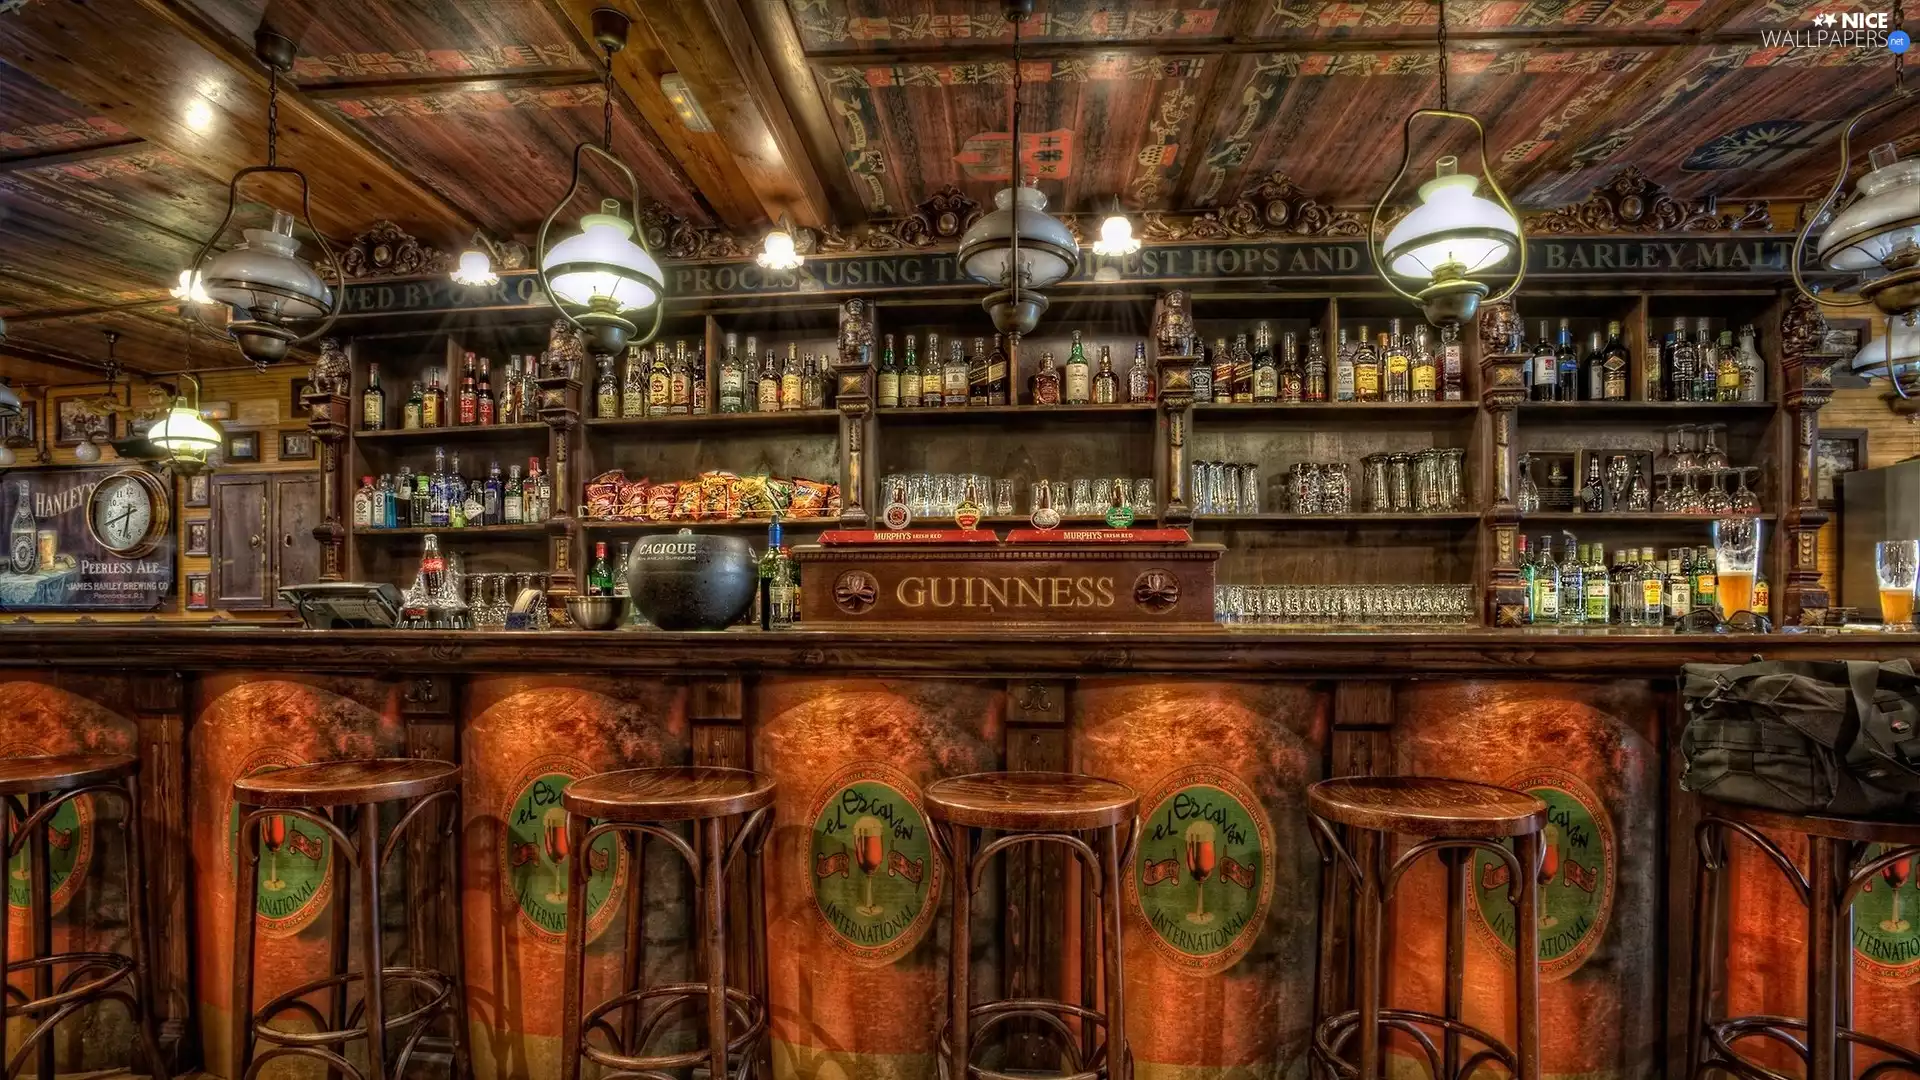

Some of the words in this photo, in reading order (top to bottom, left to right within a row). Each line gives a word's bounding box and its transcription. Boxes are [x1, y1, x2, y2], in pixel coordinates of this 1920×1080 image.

[403, 284, 440, 308] BY
[825, 258, 924, 286] USING
[1192, 248, 1281, 275] HOPS
[1289, 246, 1359, 272] AND
[1546, 242, 1687, 268] BARLEY
[1697, 241, 1794, 269] MALT
[639, 543, 697, 555] CACIQUE
[81, 559, 133, 575] PEERLESS
[136, 559, 160, 574] ALE
[93, 582, 121, 591] HANLEY
[123, 582, 157, 591] BREWING
[896, 576, 1116, 608] GUINNESS
[824, 900, 917, 942] INTERNATIONAL
[1151, 908, 1247, 951] INTERNATIONAL
